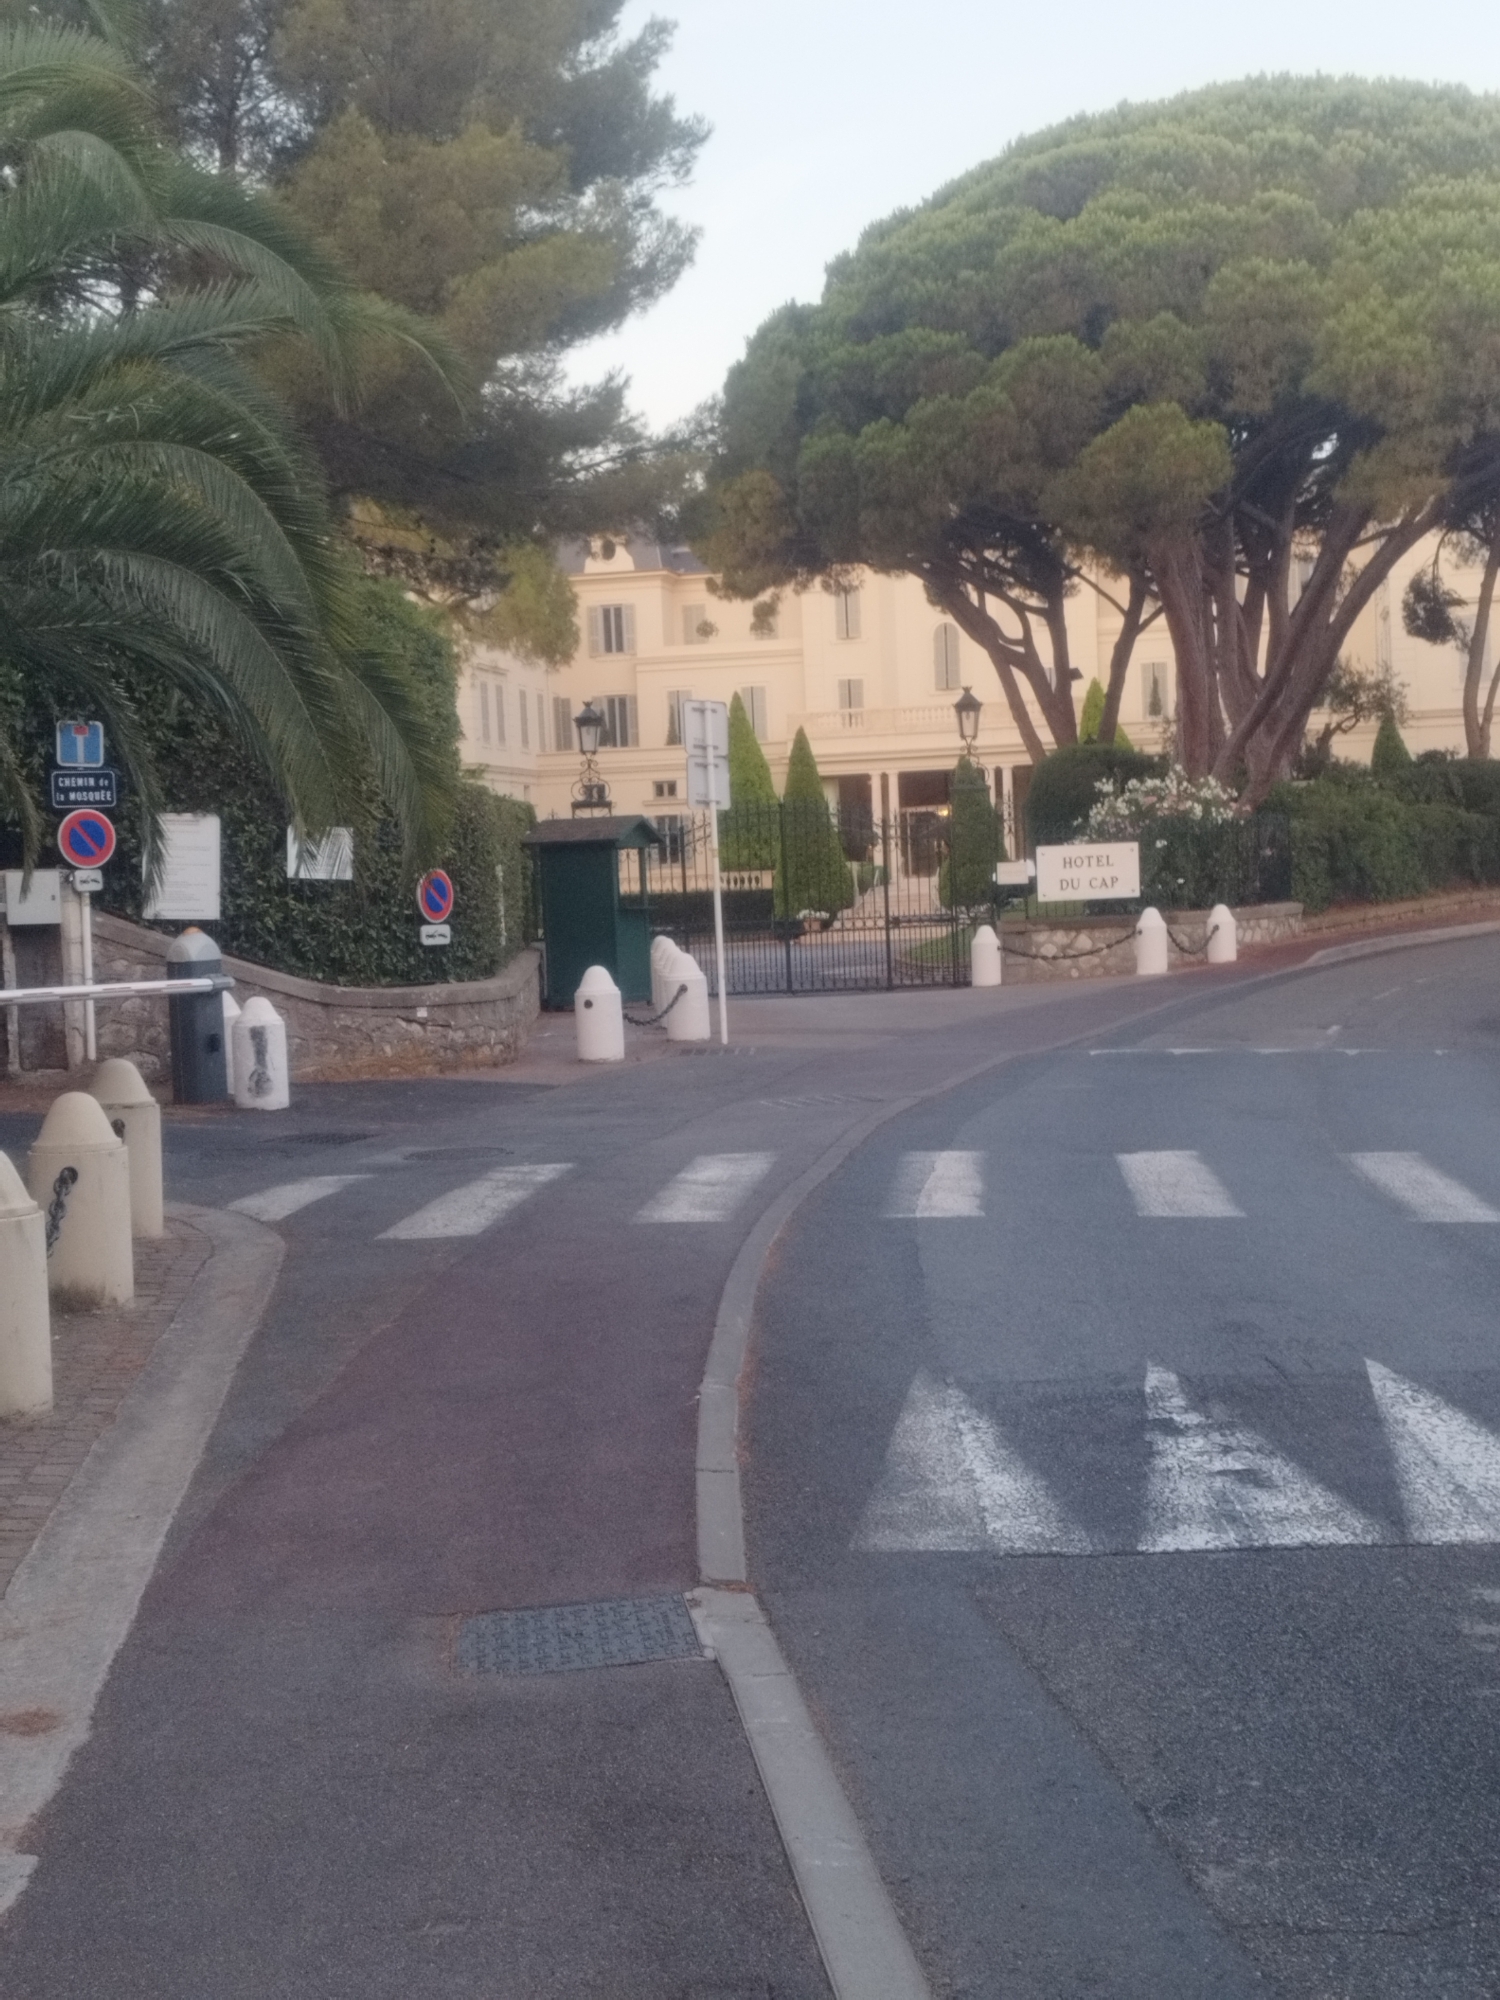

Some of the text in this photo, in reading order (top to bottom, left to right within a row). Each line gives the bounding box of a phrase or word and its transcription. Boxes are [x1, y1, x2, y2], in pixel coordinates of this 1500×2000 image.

[58, 777, 109, 787] CHEMIN de
[1062, 855, 1115, 869] HOTEL
[1059, 876, 1119, 891] DU CAP
